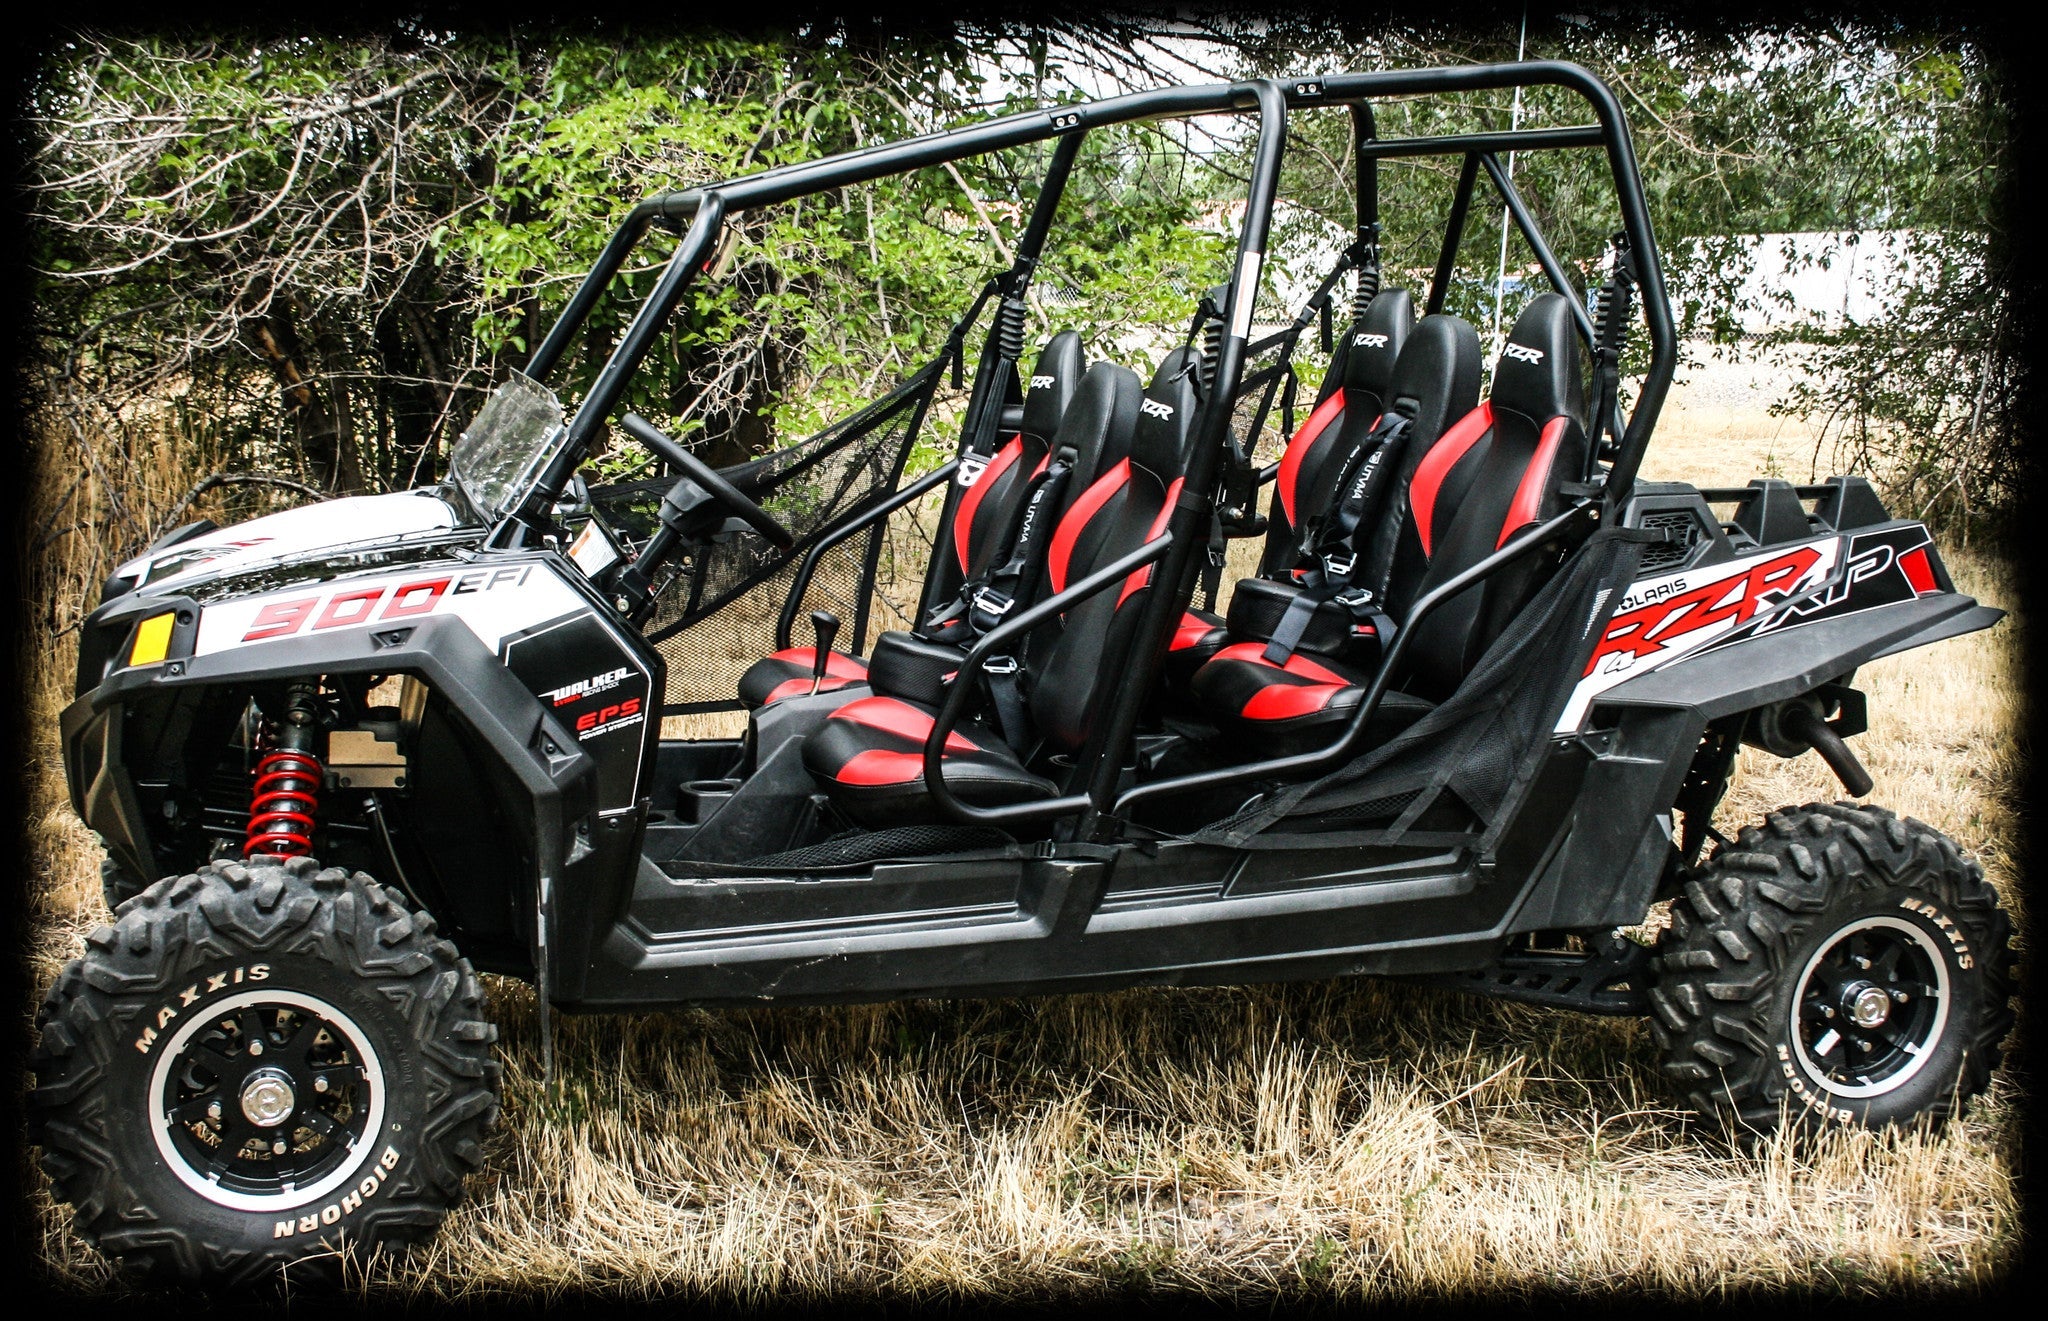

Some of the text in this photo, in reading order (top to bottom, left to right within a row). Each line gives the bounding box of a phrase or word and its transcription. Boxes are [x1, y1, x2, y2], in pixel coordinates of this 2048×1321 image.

[1352, 333, 1388, 349] RZR
[1503, 343, 1544, 365] RZR
[1139, 396, 1174, 421] RZR
[241, 566, 533, 642] 900 EFI
[1581, 545, 1894, 678] RZR XP
[1620, 578, 1687, 610] OLARIS
[538, 667, 639, 702] WALKER
[576, 697, 641, 731] EPS
[1899, 897, 1974, 970] MAXXIS
[134, 963, 271, 1054] MAXXIS
[273, 1145, 400, 1239] BIGHORN
